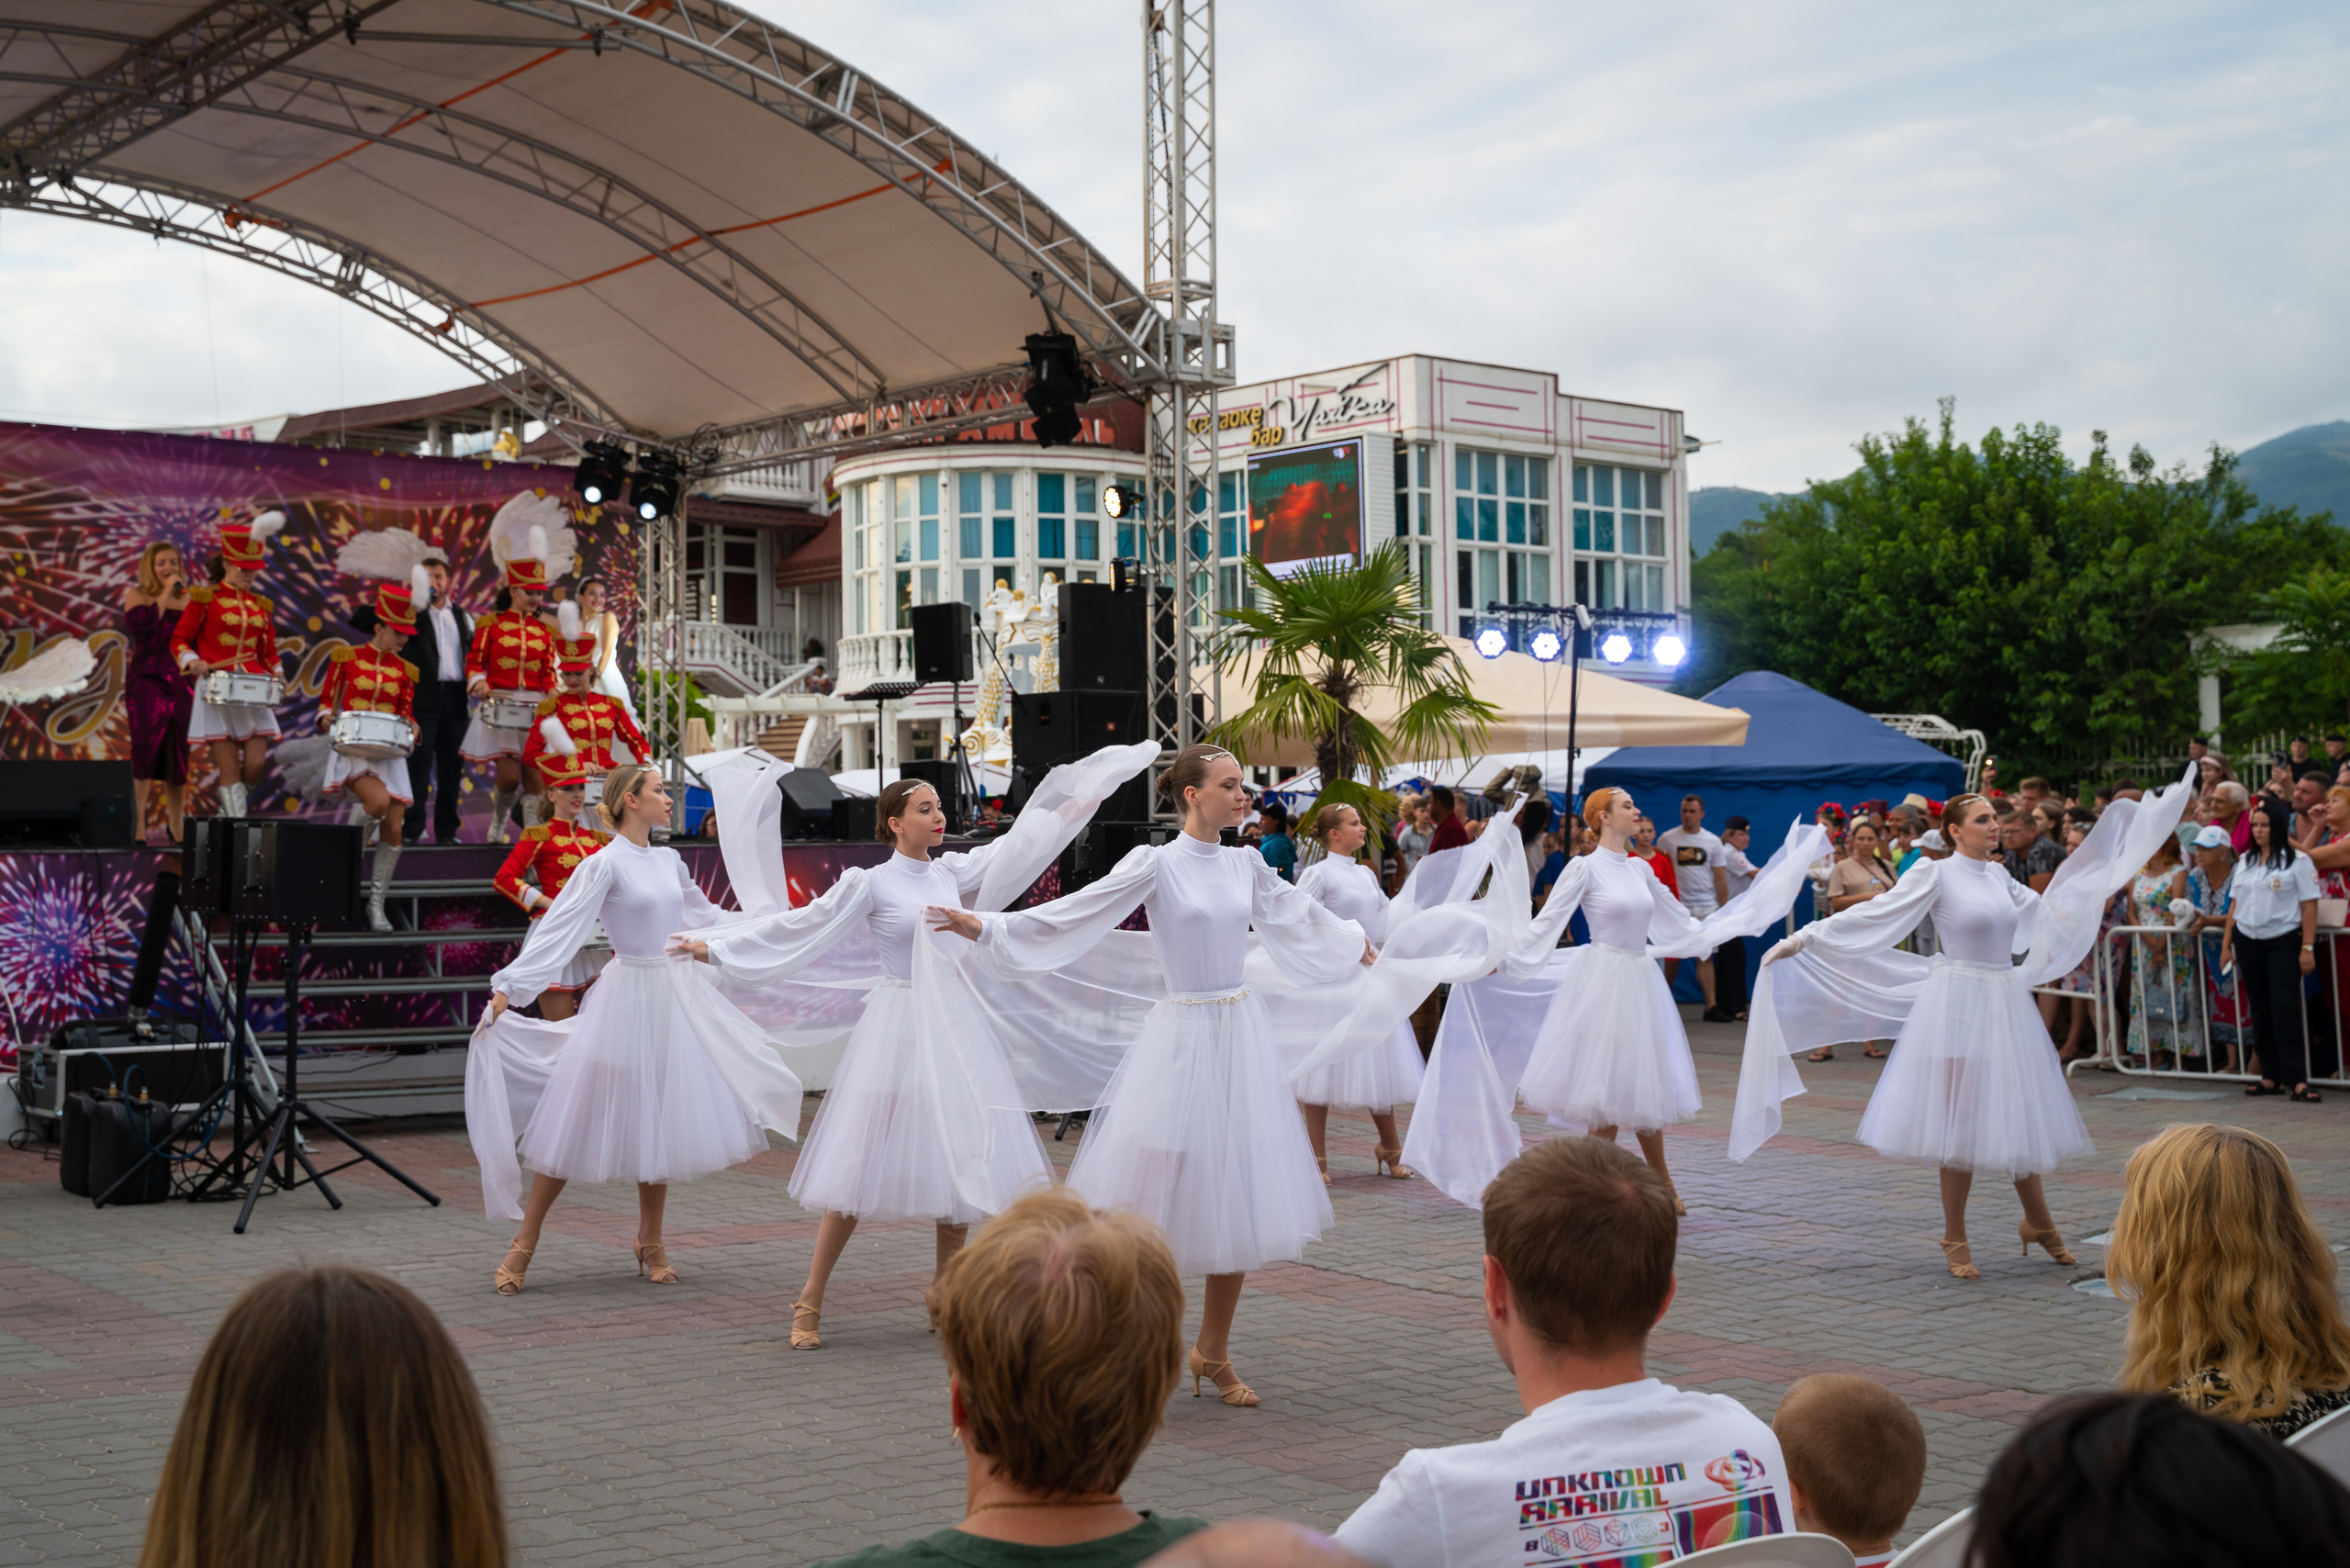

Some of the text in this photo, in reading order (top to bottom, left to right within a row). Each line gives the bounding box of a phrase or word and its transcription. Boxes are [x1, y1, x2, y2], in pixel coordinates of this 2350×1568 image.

[1189, 406, 1263, 435] кааоке
[1249, 423, 1283, 447] бар
[1519, 1487, 1669, 1524] ARRIVAL
